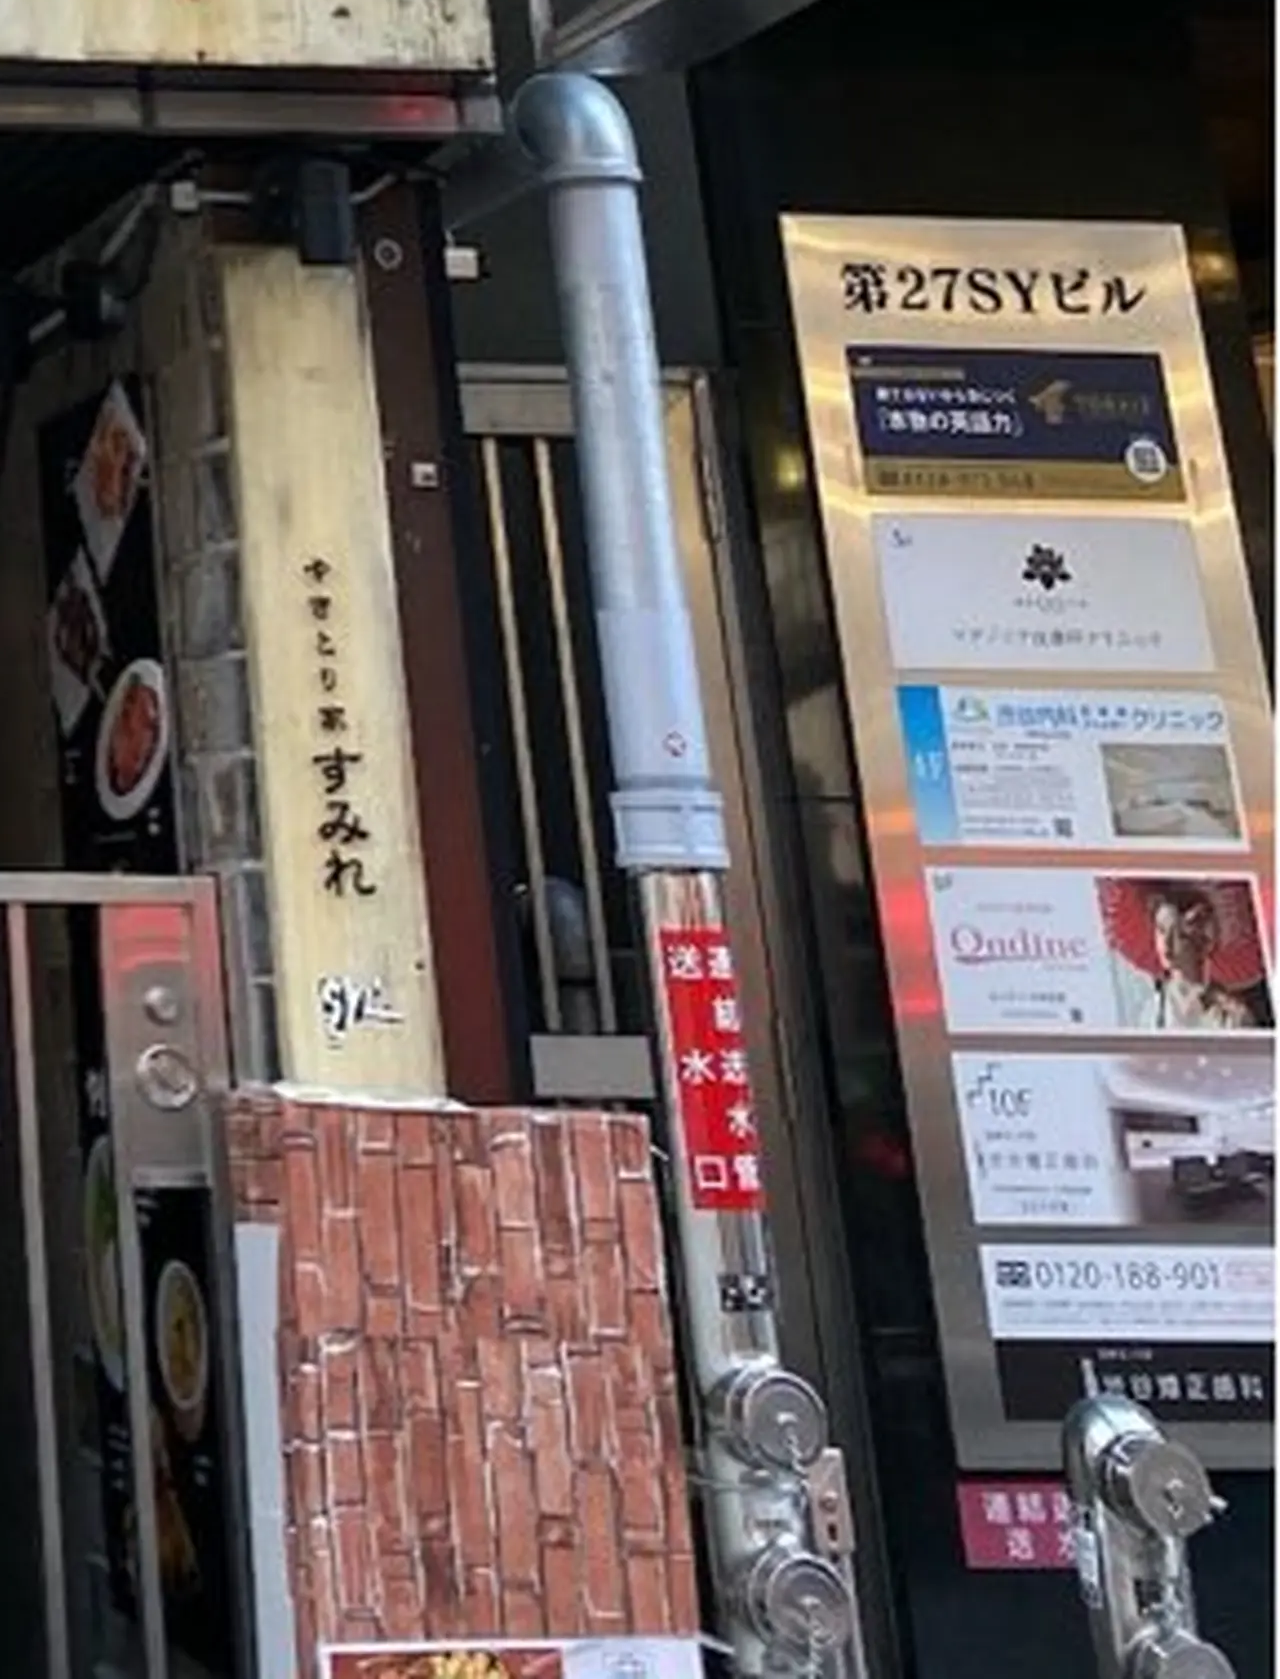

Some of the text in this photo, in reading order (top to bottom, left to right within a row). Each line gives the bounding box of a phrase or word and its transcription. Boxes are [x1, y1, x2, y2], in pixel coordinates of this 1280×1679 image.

[840, 262, 1146, 316] 第27SYビル
[311, 746, 378, 898] すみれ
[667, 944, 728, 1191] 送水口
